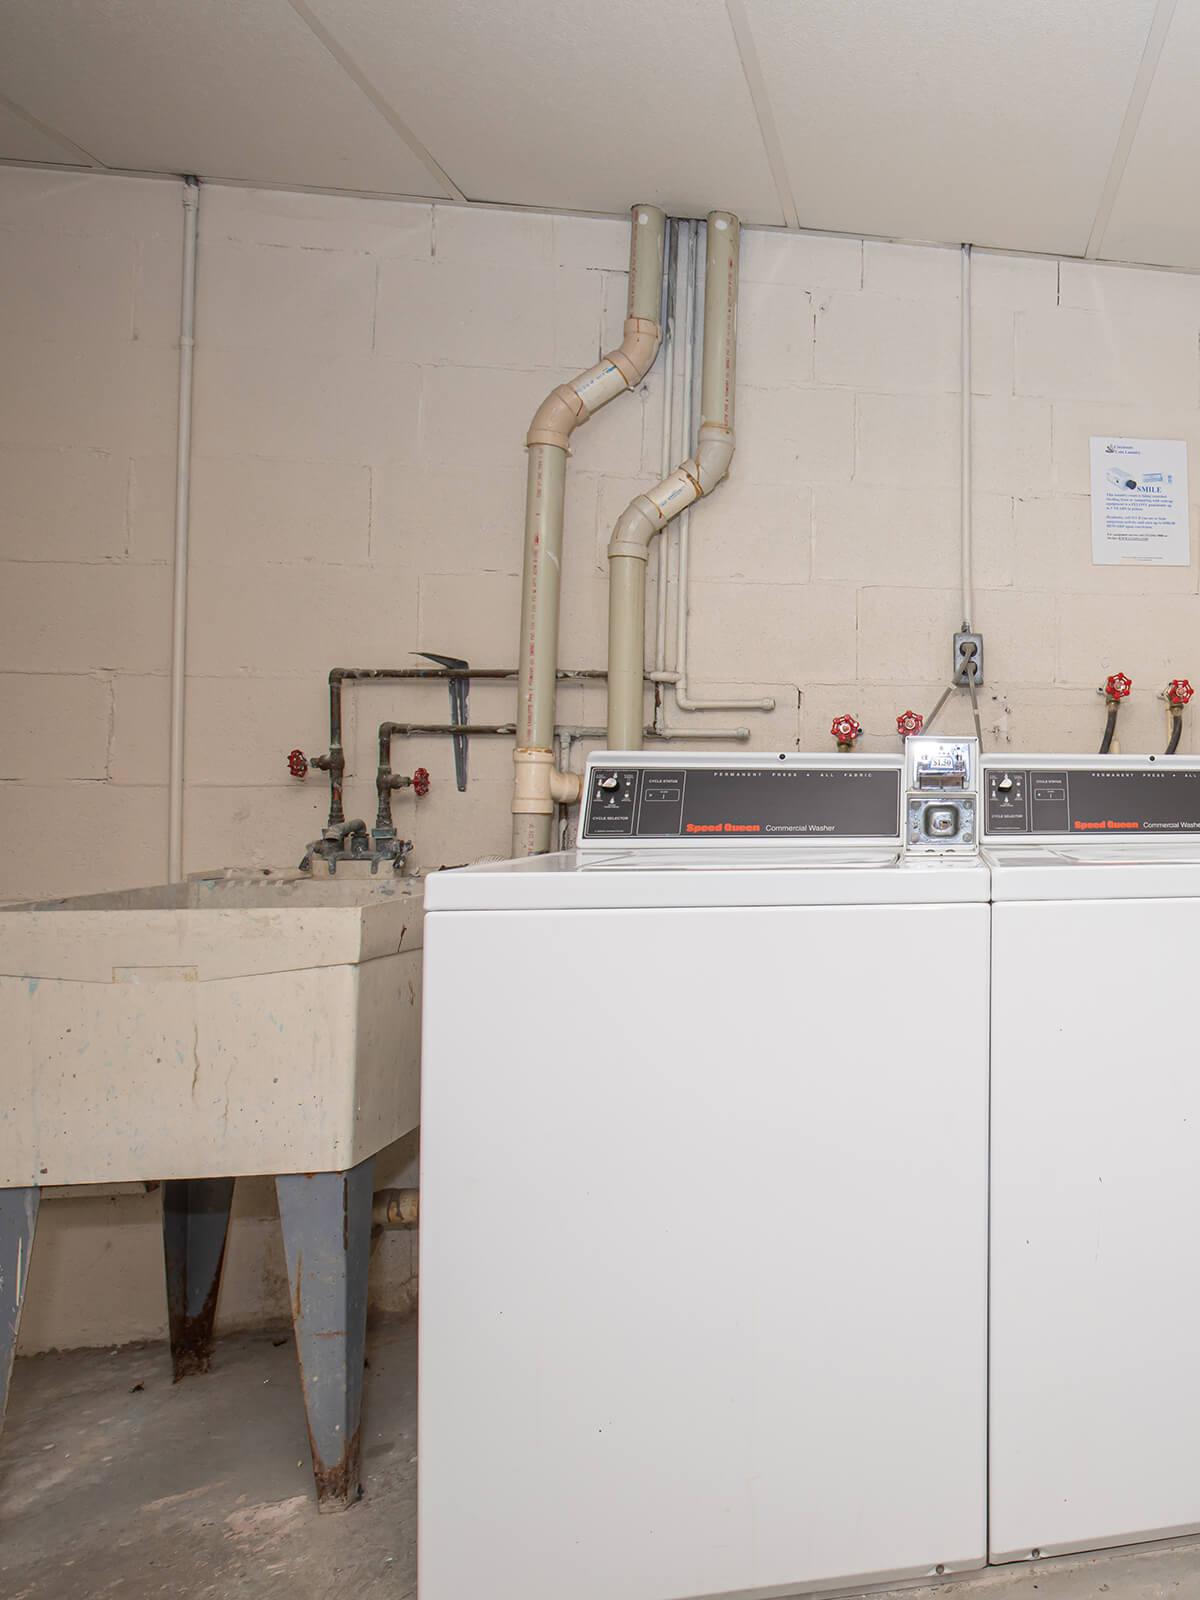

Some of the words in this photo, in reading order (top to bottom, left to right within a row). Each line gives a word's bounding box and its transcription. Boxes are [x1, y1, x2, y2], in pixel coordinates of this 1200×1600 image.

[686, 823, 722, 833] Speed
[724, 823, 761, 832] Queen
[765, 824, 808, 832] Commercial
[808, 824, 835, 832] Washer
[1074, 820, 1106, 830] Speed
[1107, 820, 1139, 829] Queen
